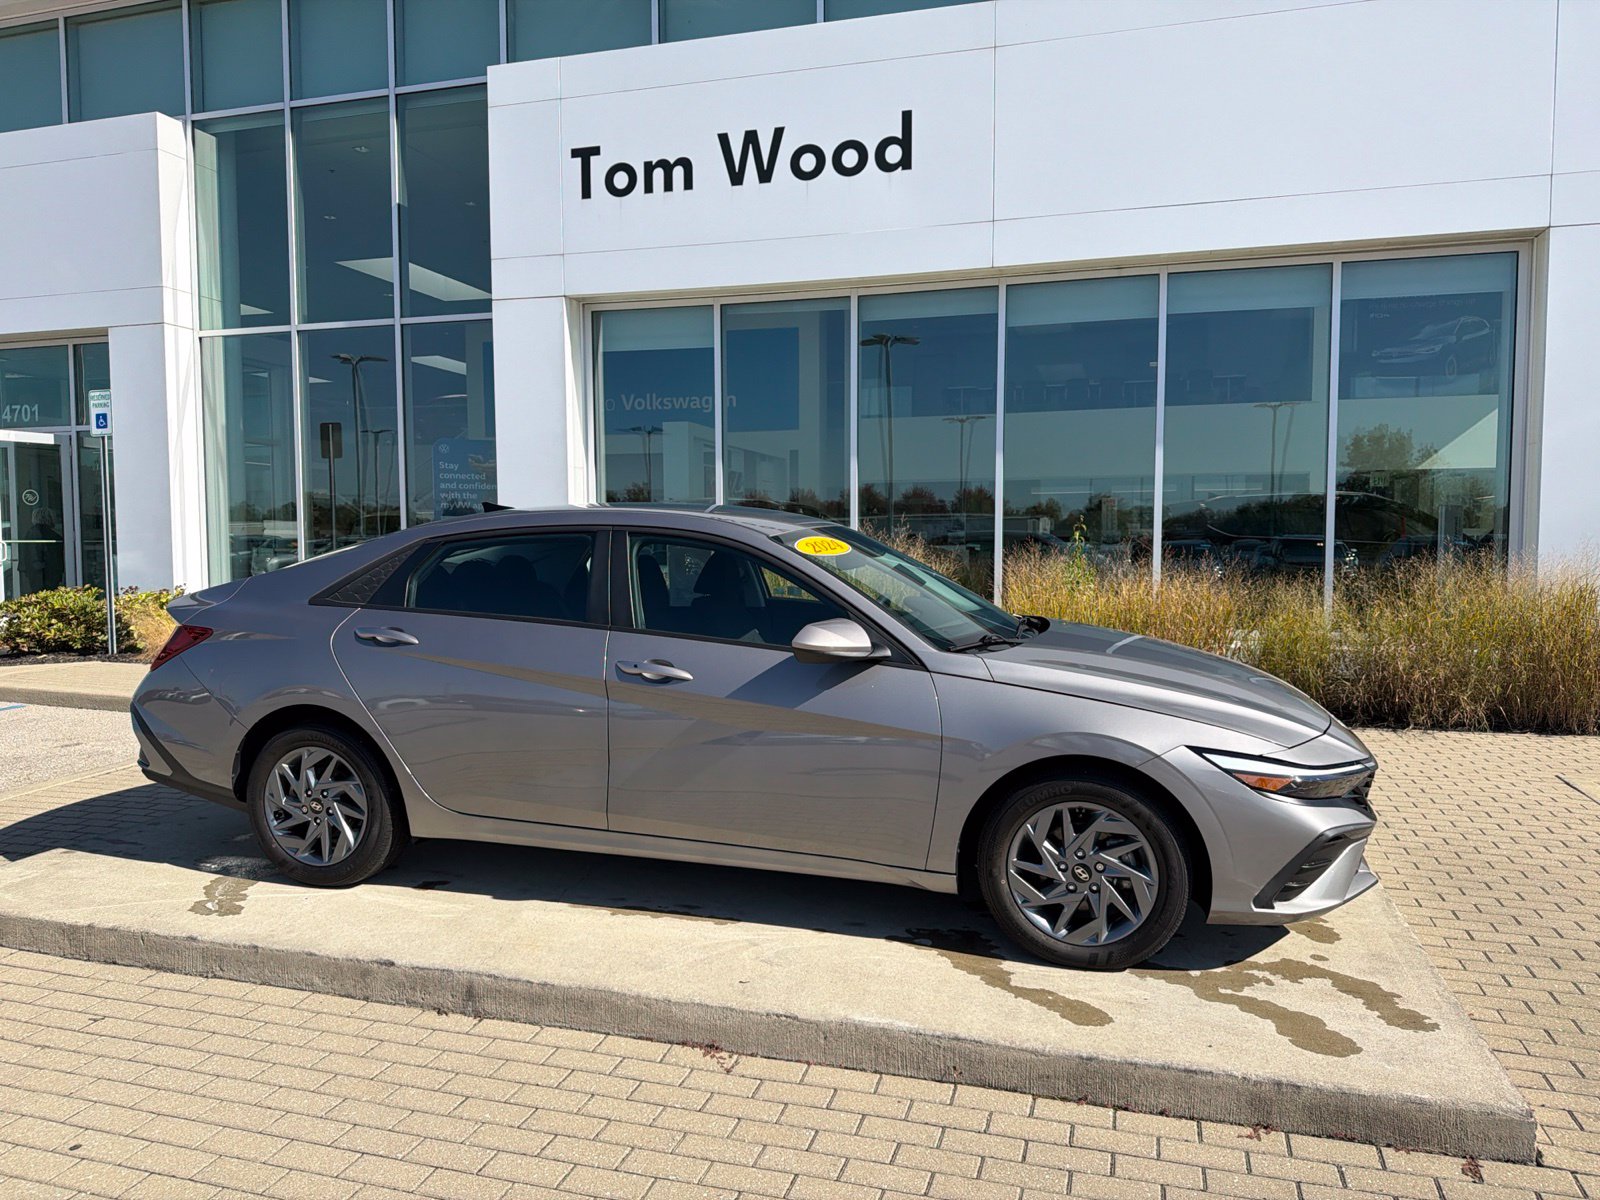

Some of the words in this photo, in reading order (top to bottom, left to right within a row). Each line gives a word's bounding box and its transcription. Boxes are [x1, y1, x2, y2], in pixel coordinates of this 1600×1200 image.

[570, 145, 694, 200] Tom
[717, 109, 913, 187] Wood
[620, 392, 738, 413] Volkswagn
[1, 403, 40, 422] 4701
[439, 461, 459, 471] Stay
[439, 472, 486, 480] connected
[458, 482, 497, 490] confiden
[440, 491, 461, 499] with
[462, 491, 478, 499] the
[805, 539, 845, 554] 2024
